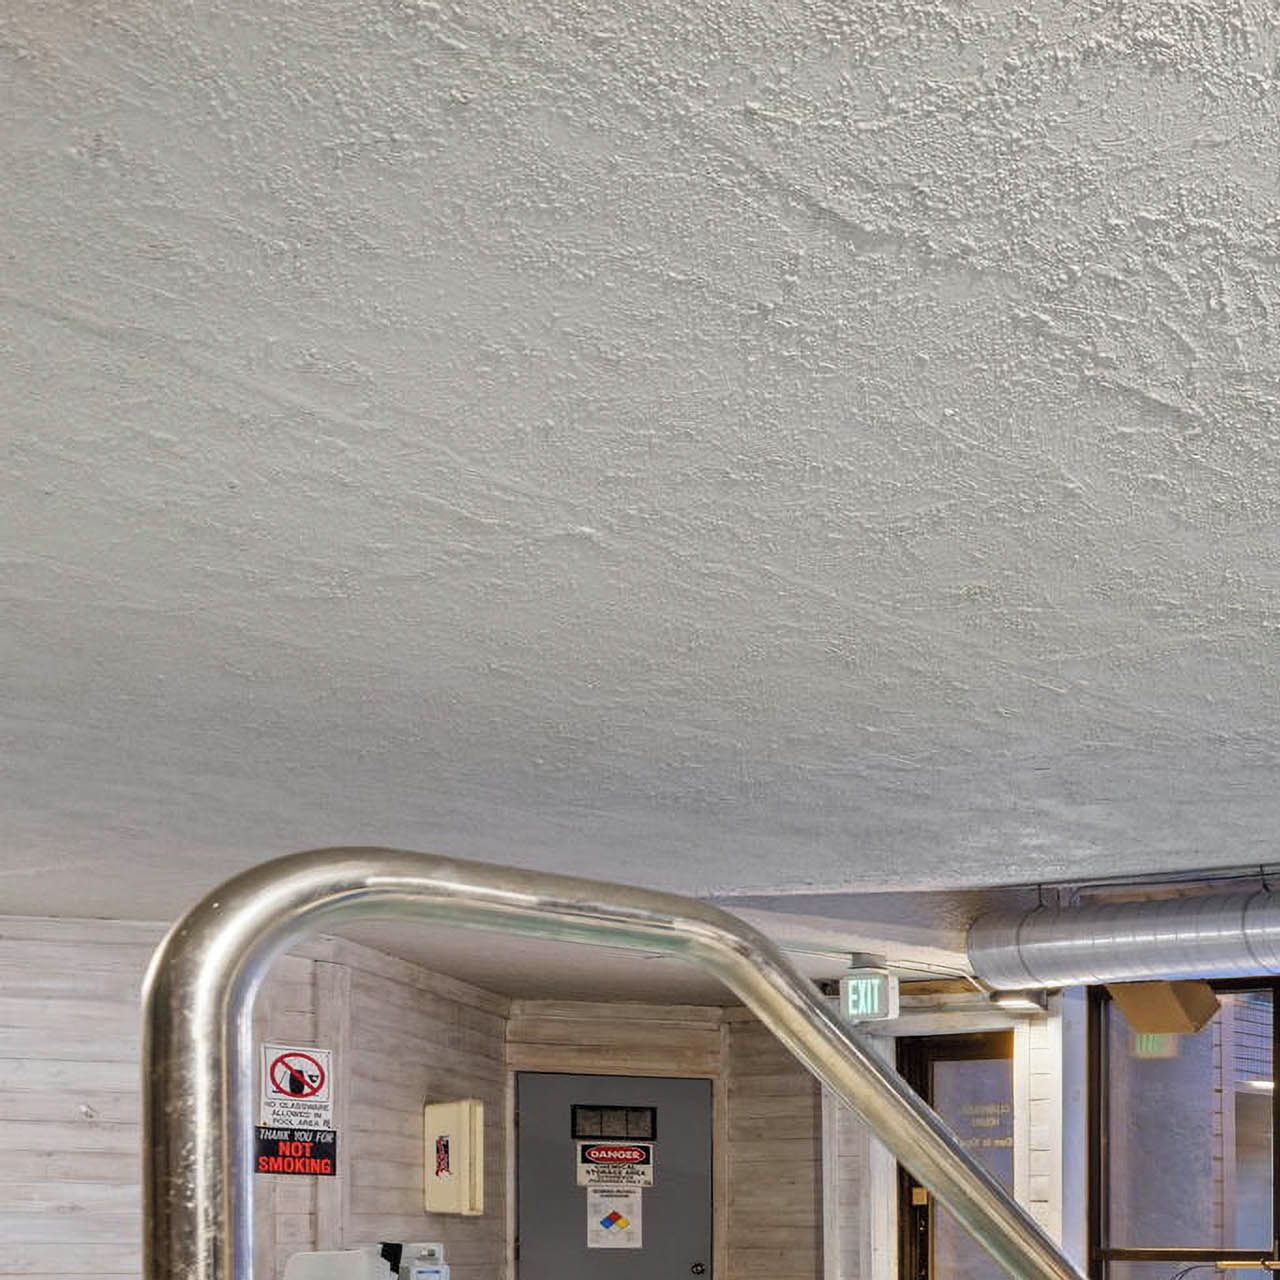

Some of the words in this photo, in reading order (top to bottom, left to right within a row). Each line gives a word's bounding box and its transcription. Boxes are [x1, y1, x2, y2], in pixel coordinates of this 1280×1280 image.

[848, 979, 880, 1014] EXIT
[260, 1129, 290, 1140] THANK
[294, 1130, 313, 1142] YOU
[315, 1132, 334, 1143] FOR
[278, 1142, 313, 1156] NOT
[590, 1150, 641, 1160] DANGER
[258, 1156, 331, 1174] SMOKING
